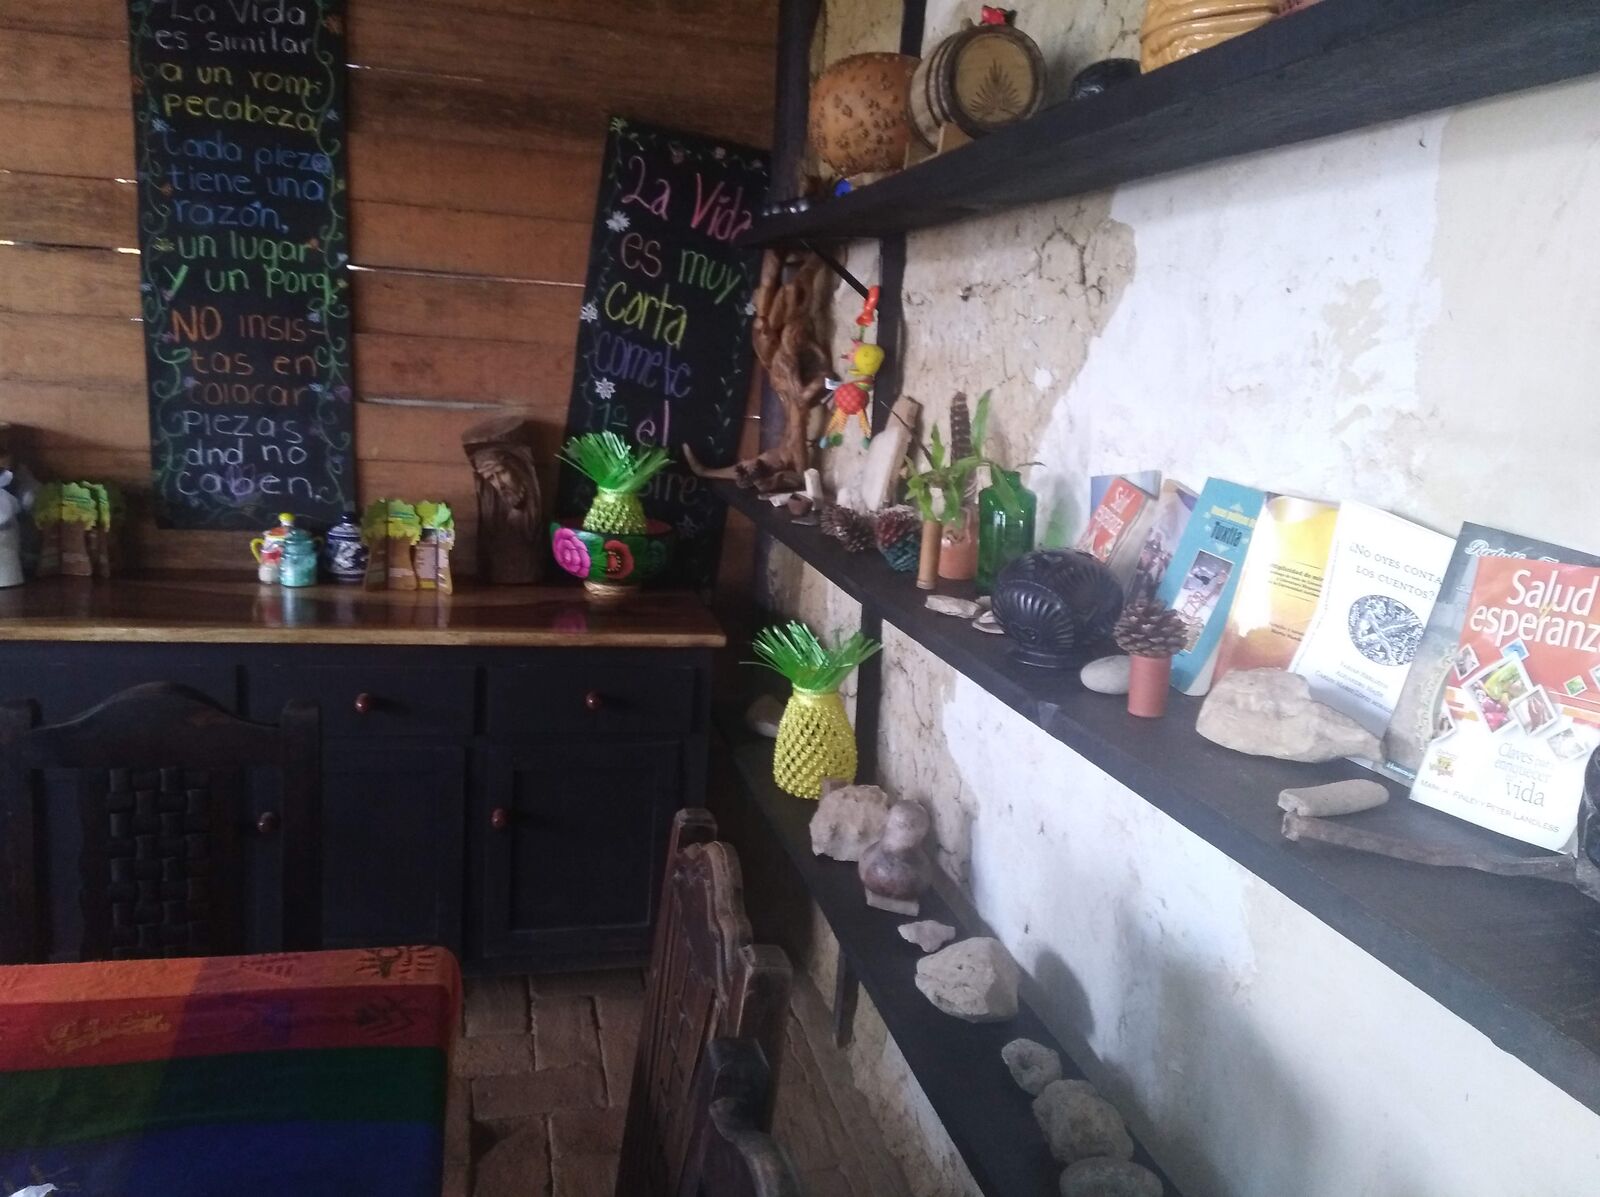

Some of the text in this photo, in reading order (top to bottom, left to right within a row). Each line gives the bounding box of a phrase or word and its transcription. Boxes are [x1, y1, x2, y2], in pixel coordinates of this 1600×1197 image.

[170, 0, 215, 23] La
[154, 30, 189, 50] es
[159, 63, 183, 82] a
[197, 65, 232, 86] un
[168, 164, 324, 201] tiene una
[690, 172, 752, 241] Vida
[178, 229, 311, 268] un lugar
[205, 267, 249, 293] un
[621, 232, 742, 304] es muy
[171, 305, 223, 343] NO
[191, 351, 317, 377] tas en
[636, 400, 669, 448] el
[261, 443, 308, 465] no
[1403, 566, 1443, 584] CONTA
[1507, 568, 1600, 616] Salud
[1470, 605, 1600, 652] esperanz
[1506, 780, 1545, 808] vida
